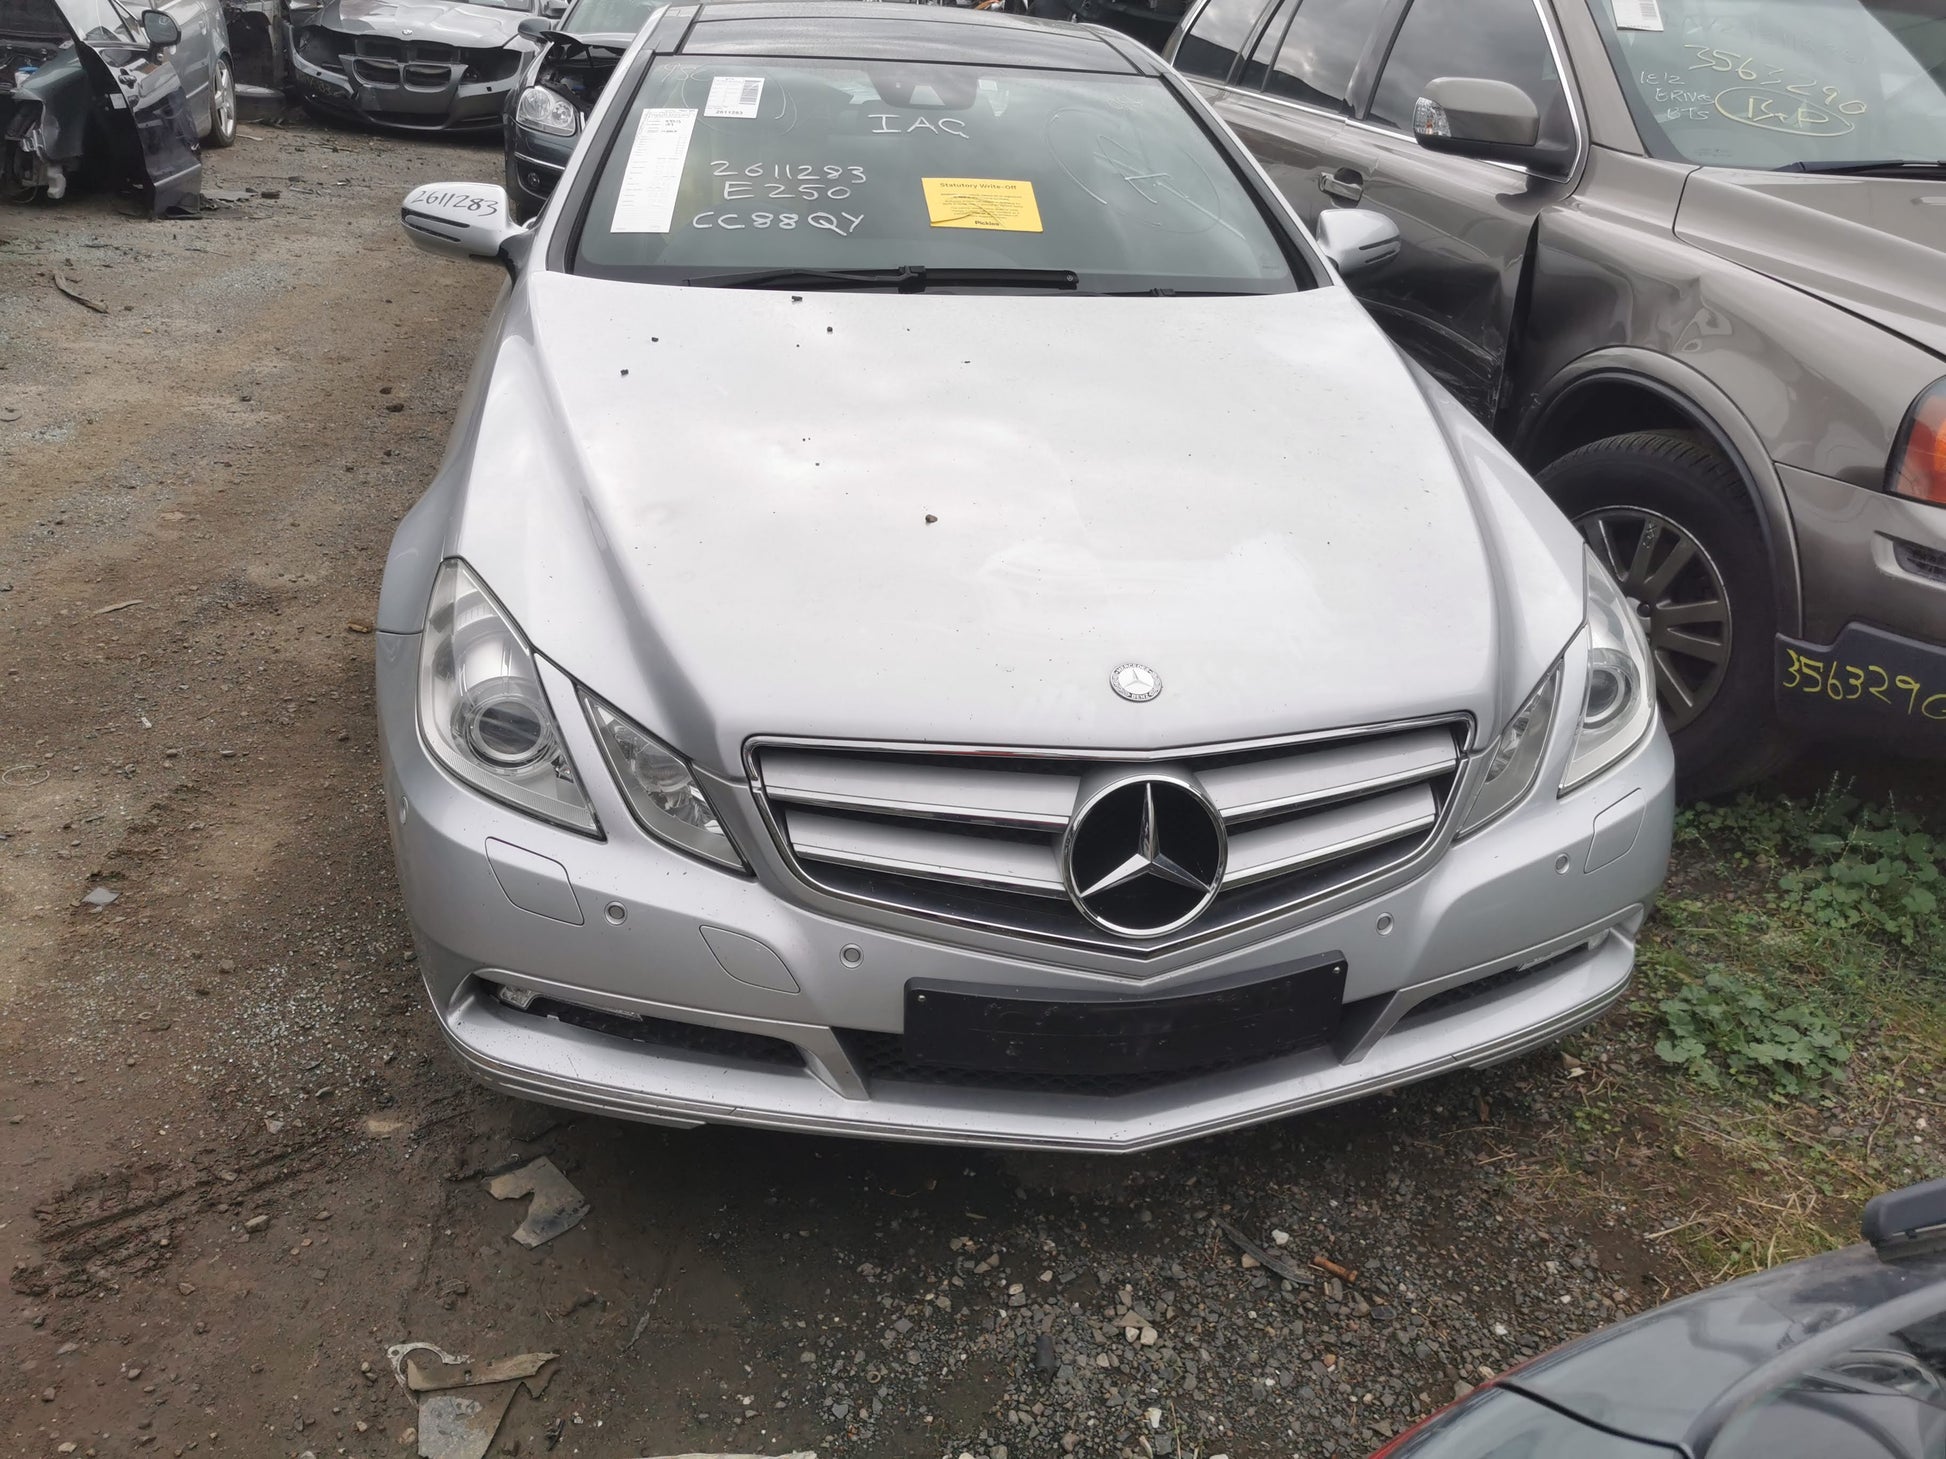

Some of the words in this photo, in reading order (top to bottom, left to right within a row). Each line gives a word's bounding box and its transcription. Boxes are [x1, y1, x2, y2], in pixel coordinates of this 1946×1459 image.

[710, 160, 867, 183] 2611283
[411, 190, 499, 217] 2611283
[692, 211, 865, 236] CC88QY
